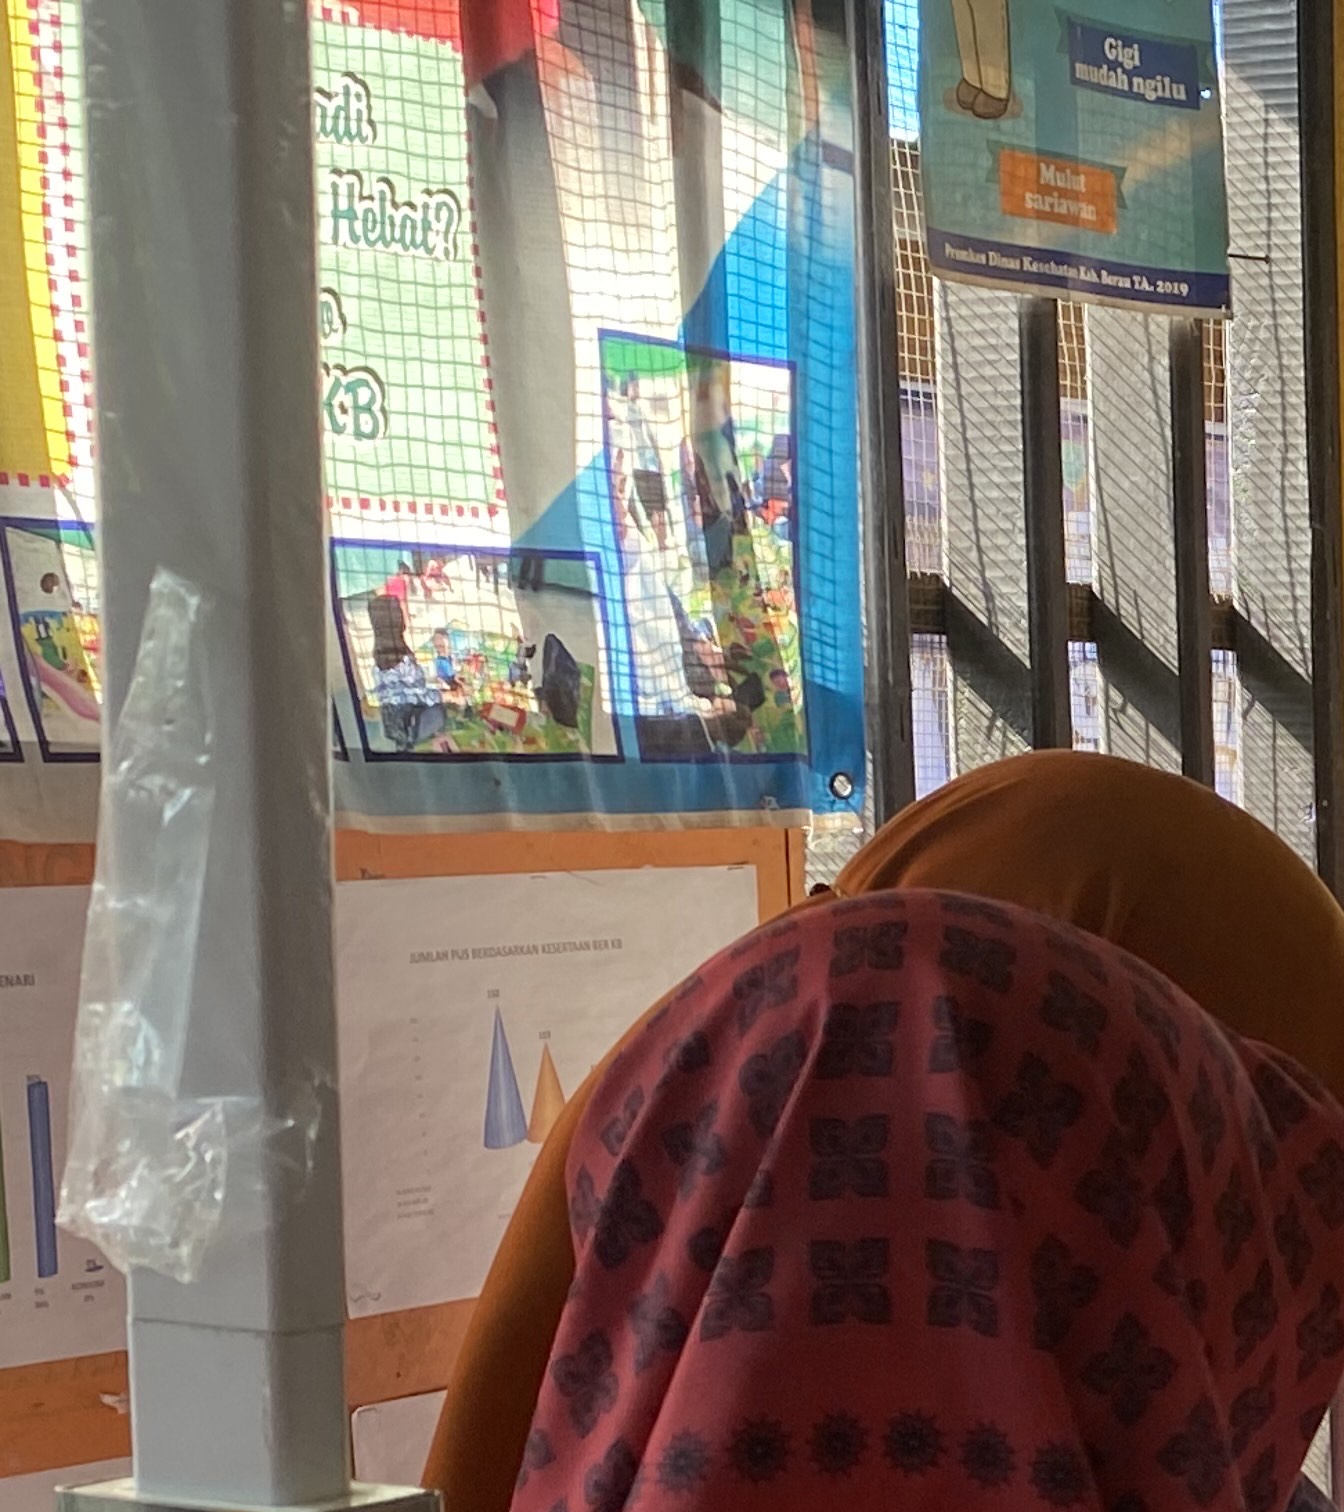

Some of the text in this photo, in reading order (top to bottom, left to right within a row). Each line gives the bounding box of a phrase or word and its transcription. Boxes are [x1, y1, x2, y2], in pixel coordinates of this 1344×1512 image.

[1104, 37, 1140, 69] Gigi
[1075, 60, 1187, 101] mudah ngilu
[1040, 163, 1086, 191] Mulut
[331, 181, 455, 257] Hebat?
[1025, 191, 1097, 221] sariawan
[1156, 280, 1189, 296] 2019
[409, 950, 449, 964] JUMLAH
[472, 944, 539, 960] BERDASARKAN
